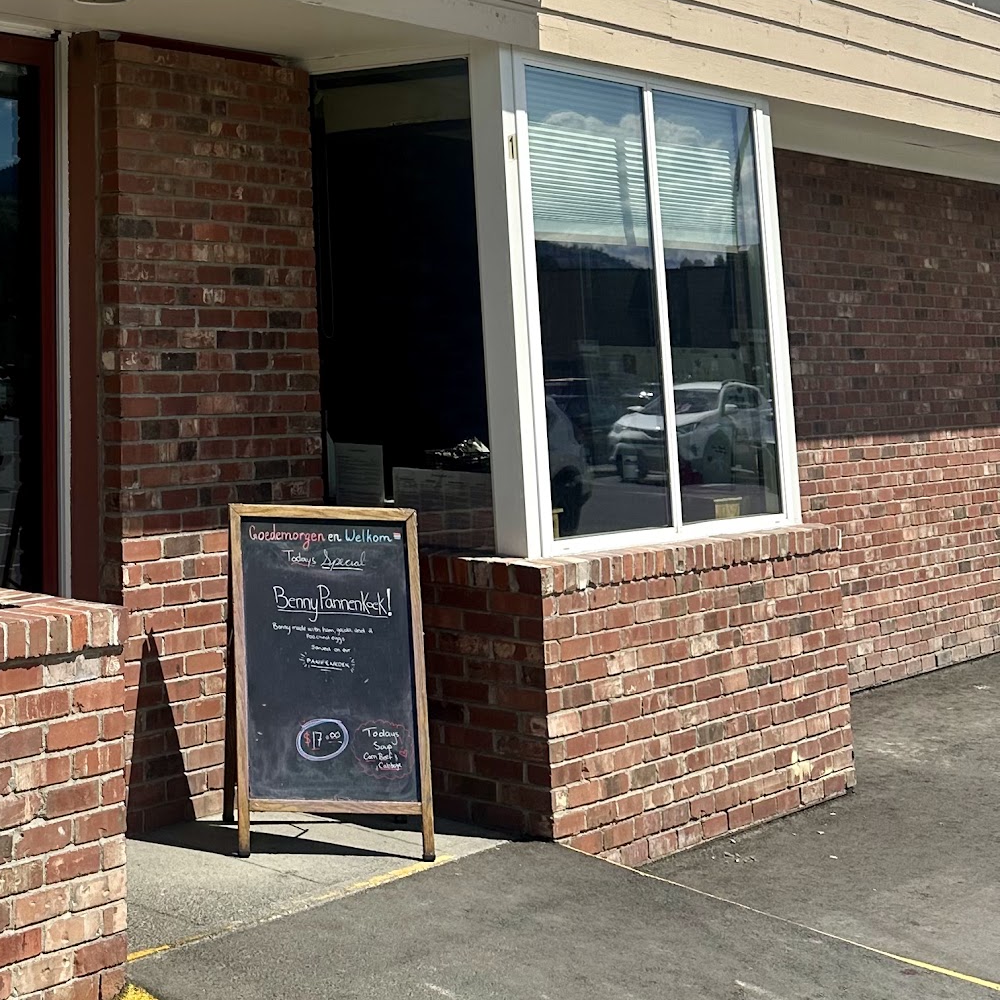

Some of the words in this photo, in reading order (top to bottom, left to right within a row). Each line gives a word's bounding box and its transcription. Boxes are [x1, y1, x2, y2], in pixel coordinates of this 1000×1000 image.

[249, 524, 325, 550] Goedemorgen
[328, 532, 342, 542] en
[344, 528, 393, 543] Welkom
[282, 550, 317, 567] Todays
[321, 549, 366, 572] Special
[272, 585, 319, 622] Benny
[362, 727, 400, 745] Todays
[373, 741, 393, 752] Soup
